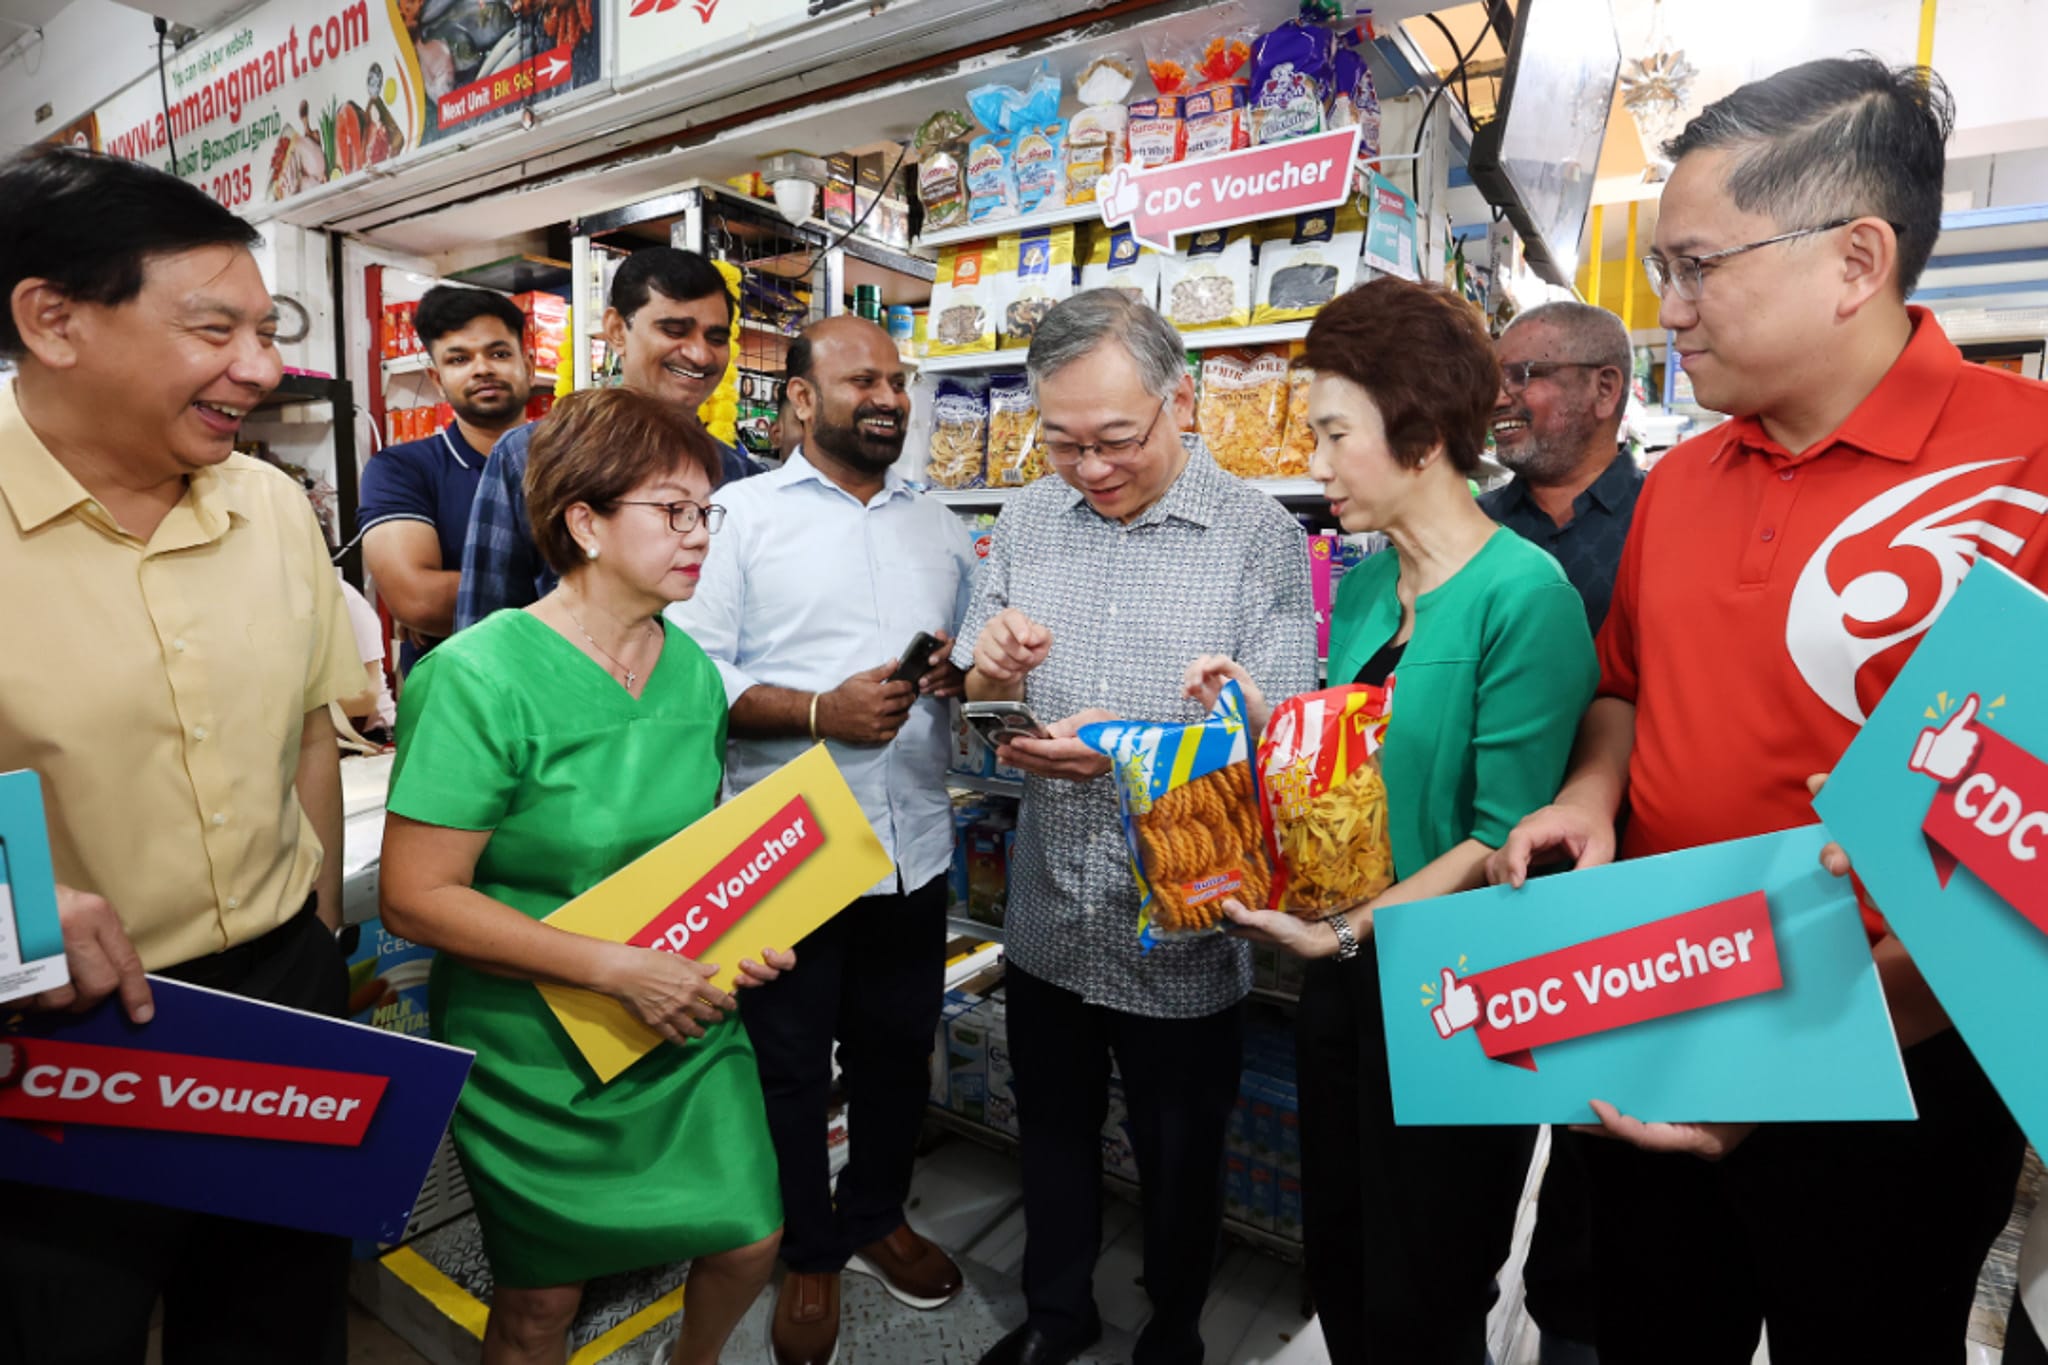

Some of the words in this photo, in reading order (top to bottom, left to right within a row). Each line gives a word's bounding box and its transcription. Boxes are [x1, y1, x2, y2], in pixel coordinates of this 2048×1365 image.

[185, 63, 197, 80] can
[226, 28, 253, 59] website
[442, 97, 466, 122] Next
[468, 86, 490, 112] Unit
[494, 80, 511, 101] Blk
[1144, 181, 1203, 216] CDC
[1211, 158, 1333, 203] Voucher
[1954, 772, 2048, 862] CDC
[706, 815, 807, 910] Voucher
[1485, 977, 1567, 1030] CDC
[1574, 926, 1755, 1005] Voucher
[372, 998, 414, 1026] MILK
[22, 1063, 142, 1104] CDC
[157, 1074, 361, 1122] Voucher
